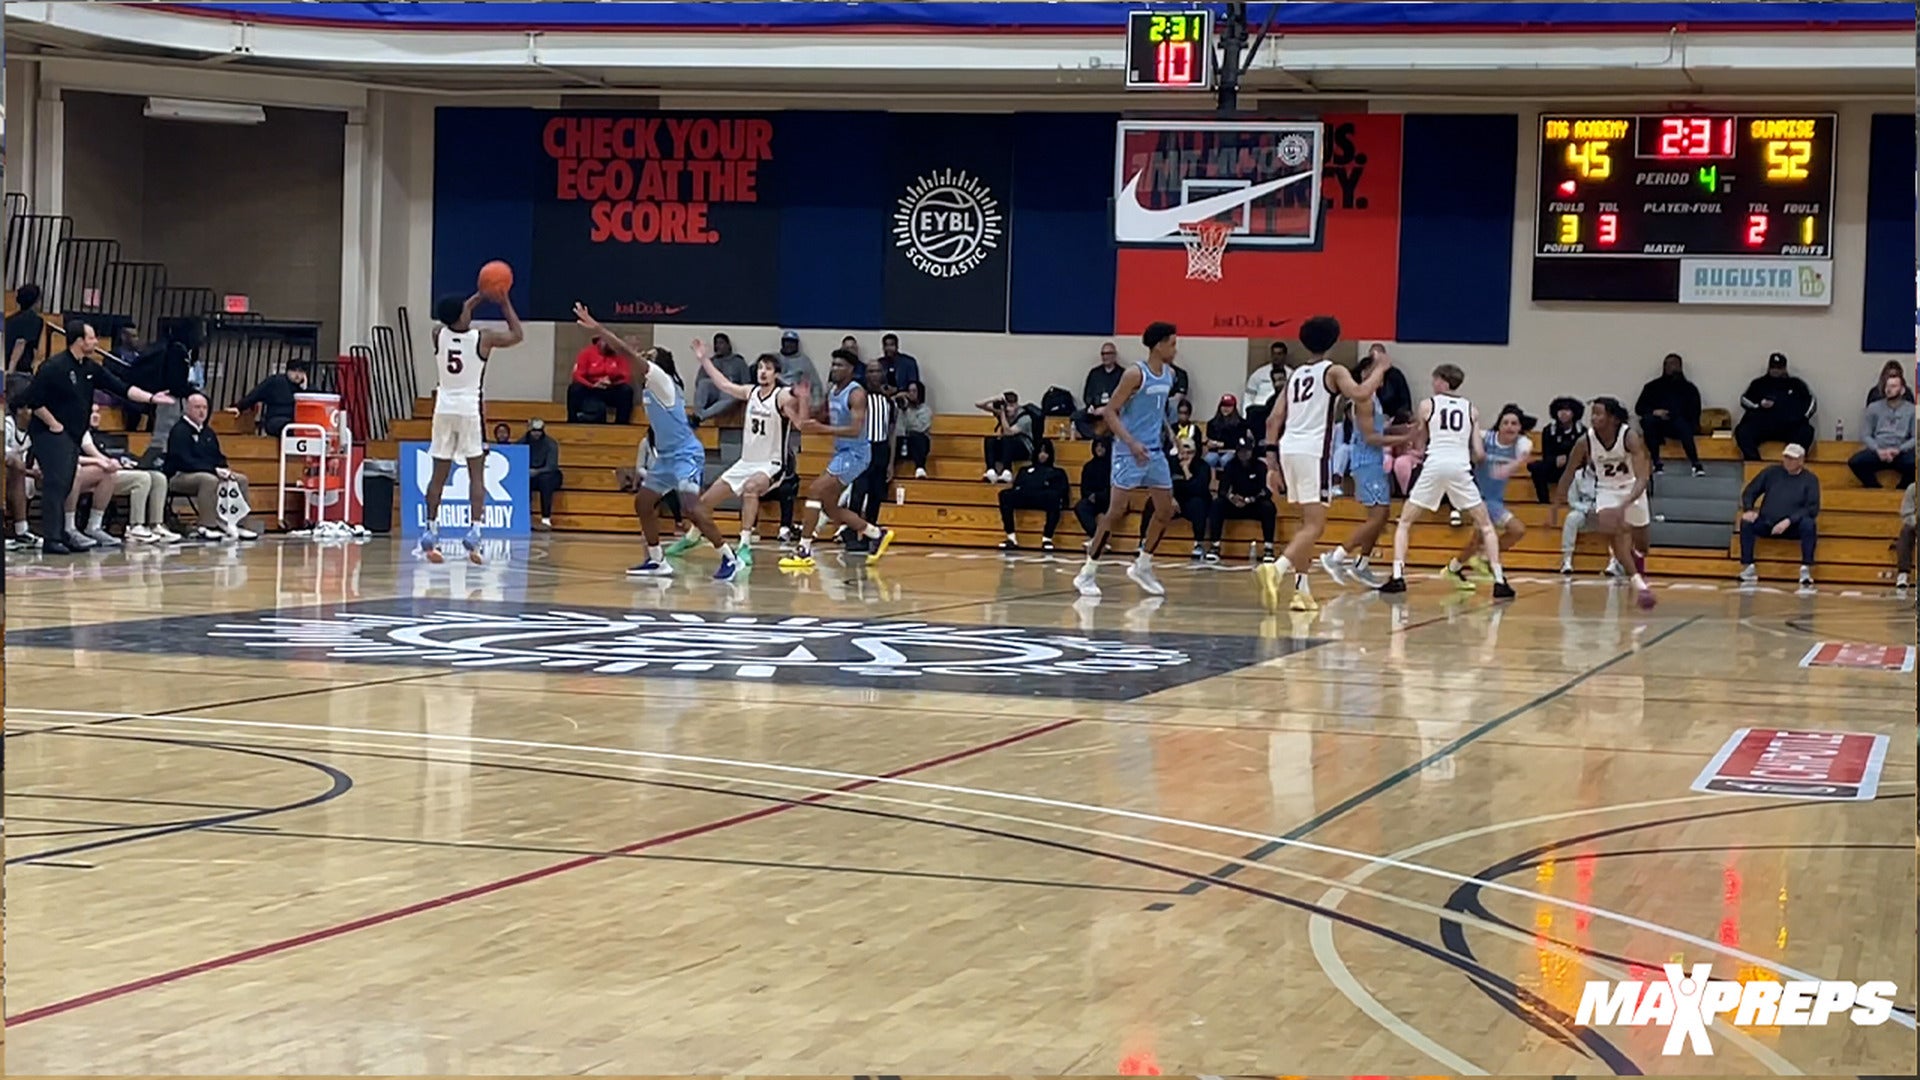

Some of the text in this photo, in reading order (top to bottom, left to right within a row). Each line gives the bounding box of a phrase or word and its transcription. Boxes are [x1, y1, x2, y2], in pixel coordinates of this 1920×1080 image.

[1150, 16, 1199, 41] 2:31
[1157, 41, 1190, 82] 10
[543, 117, 773, 160] CHECK YOUR
[1661, 118, 1732, 154] 2:31
[1751, 120, 1815, 138] SUNRISE
[1569, 141, 1610, 177] 45
[1767, 141, 1811, 178] 52
[557, 159, 757, 202] EGO AT THE
[1636, 165, 1716, 192] PERIOD 4
[1548, 202, 1585, 212] FOULS
[591, 201, 720, 243] SCORE.
[920, 211, 975, 231] EYBL
[1561, 214, 1616, 243] 3 3
[1748, 215, 1814, 245] 2 1
[1543, 243, 1584, 253] POINTS
[1643, 243, 1685, 253] MATCH
[1781, 244, 1824, 254] POINTS
[905, 246, 987, 278] SCHOLASTIC
[1694, 267, 1792, 288] AUGUSTA
[447, 349, 463, 374] 5
[1293, 375, 1314, 403] 12
[751, 418, 766, 435] 31
[1440, 408, 1463, 431] 10
[296, 440, 307, 452] G
[1603, 461, 1629, 477] 24
